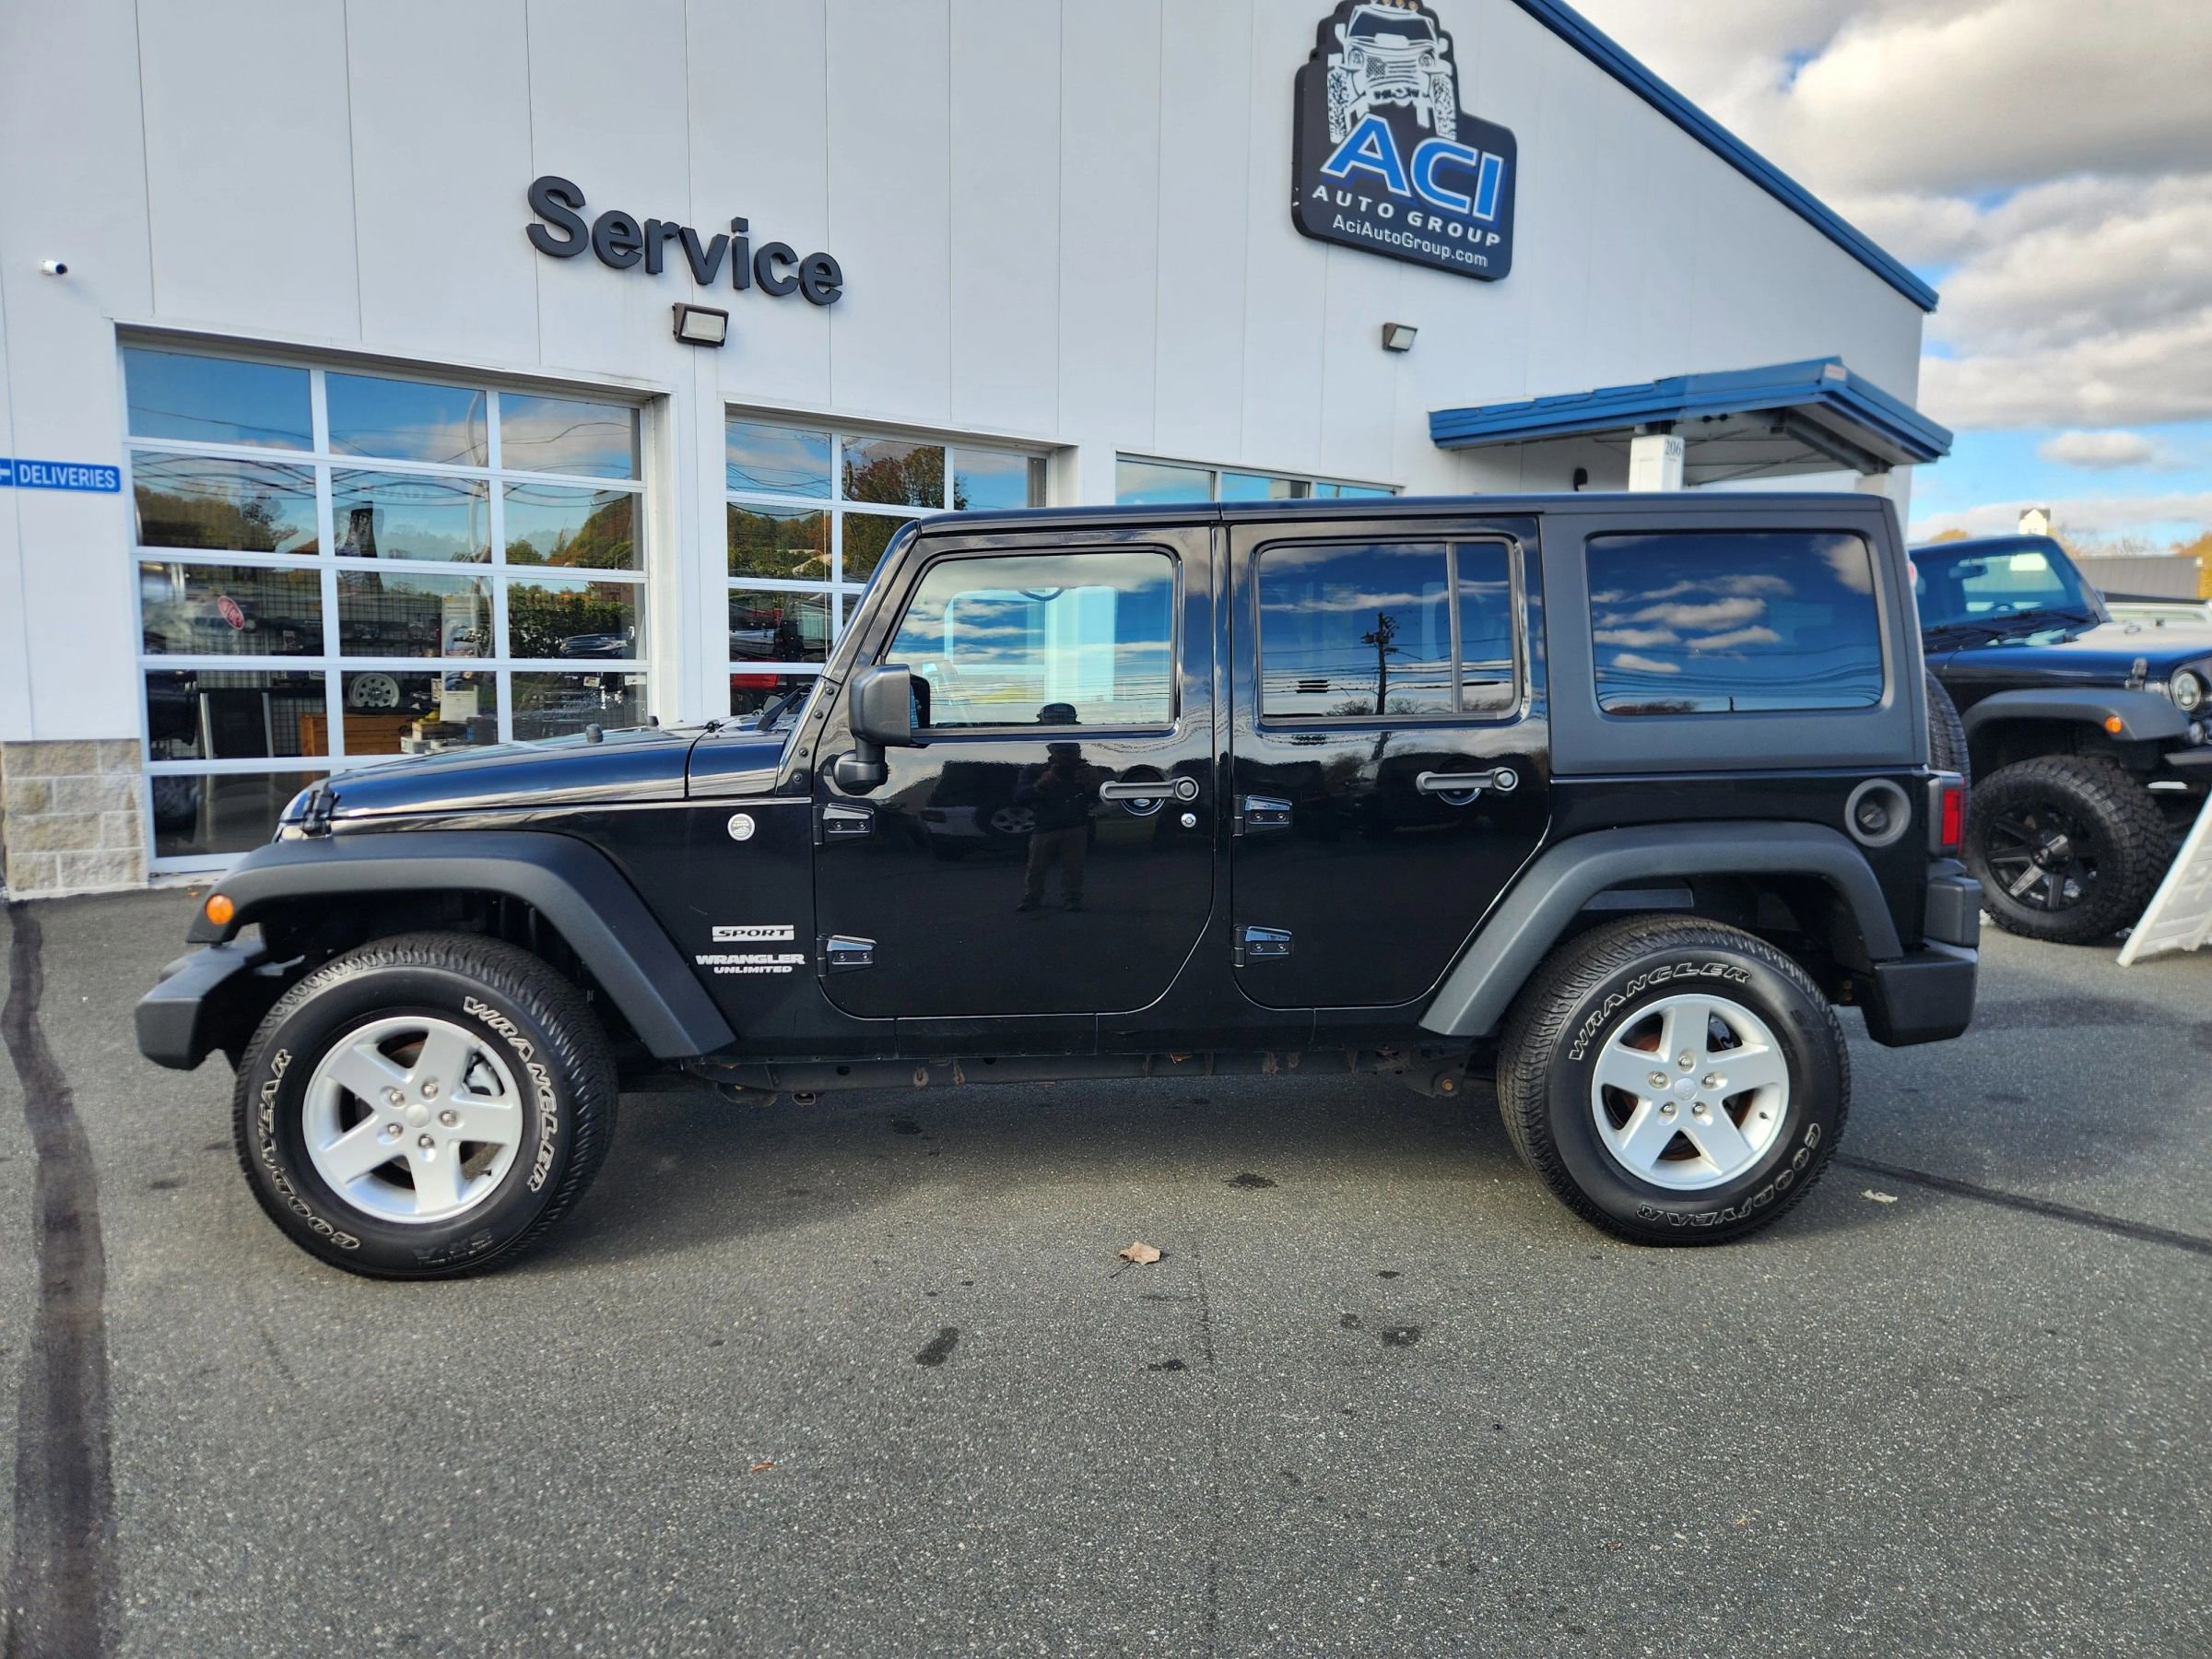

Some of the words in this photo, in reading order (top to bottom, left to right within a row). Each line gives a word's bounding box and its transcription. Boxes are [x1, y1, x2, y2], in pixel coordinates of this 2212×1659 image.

[1312, 184, 1395, 218] AUTO
[1406, 210, 1502, 247] GROUP
[1320, 112, 1504, 222] ACI
[525, 175, 843, 306] Service
[1333, 214, 1489, 268] AciAutoGroup.com
[18, 464, 116, 489] DELIVERIES
[695, 953, 806, 965] WRANGLER
[713, 965, 794, 974] UNLIMITED
[1568, 961, 1754, 1063] WRANGLER
[463, 995, 559, 1194] WRANGLER
[256, 1048, 362, 1251] GOODYEAR
[1636, 1122, 1822, 1227] GOODYEAR
